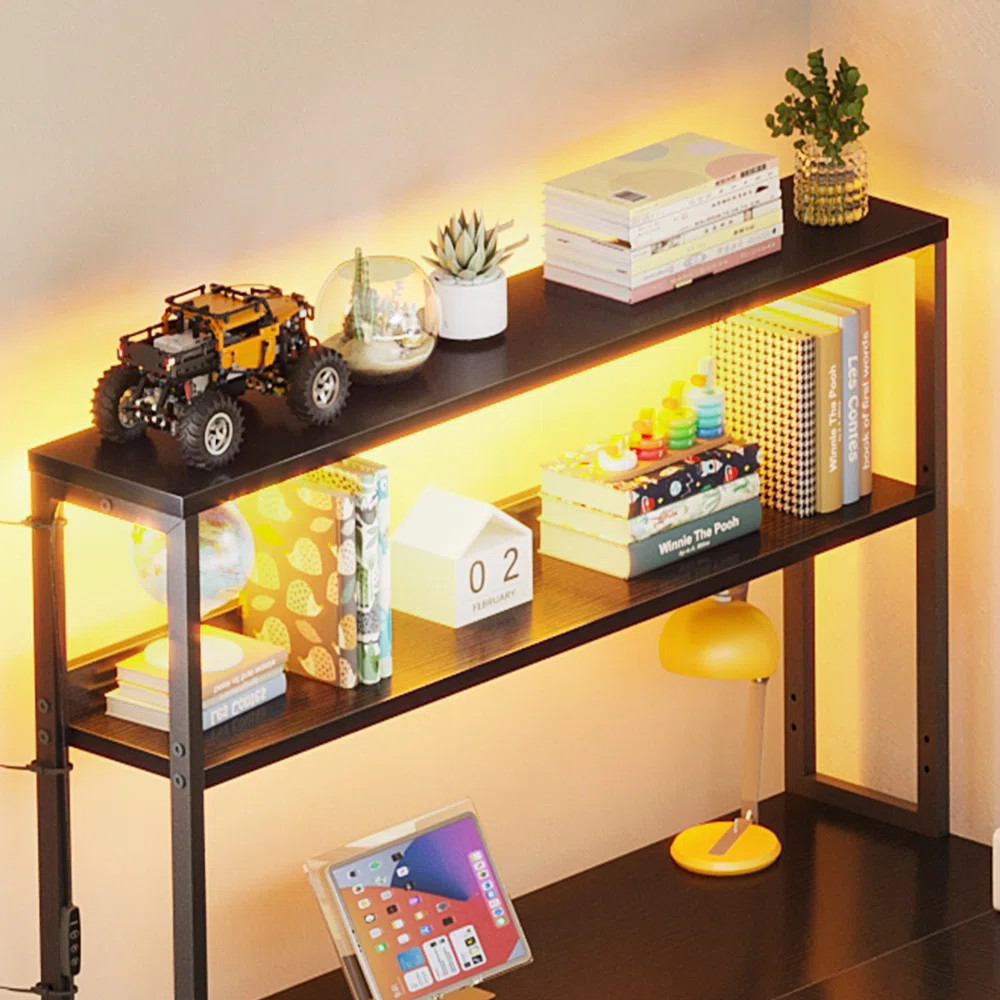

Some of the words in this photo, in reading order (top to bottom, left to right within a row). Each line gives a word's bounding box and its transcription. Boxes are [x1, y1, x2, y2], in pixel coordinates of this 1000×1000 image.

[862, 330, 870, 377] words
[828, 364, 837, 398] Pooh
[848, 355, 859, 390] Les
[862, 380, 870, 409] first
[828, 401, 837, 427] The
[848, 394, 859, 462] Contes
[862, 414, 870, 428] of
[828, 428, 837, 472] Winnie
[862, 432, 870, 470] book
[658, 534, 692, 555] Winnie
[693, 528, 712, 541] The
[714, 516, 739, 535] Pooh
[472, 589, 516, 612] FEBRUARY
